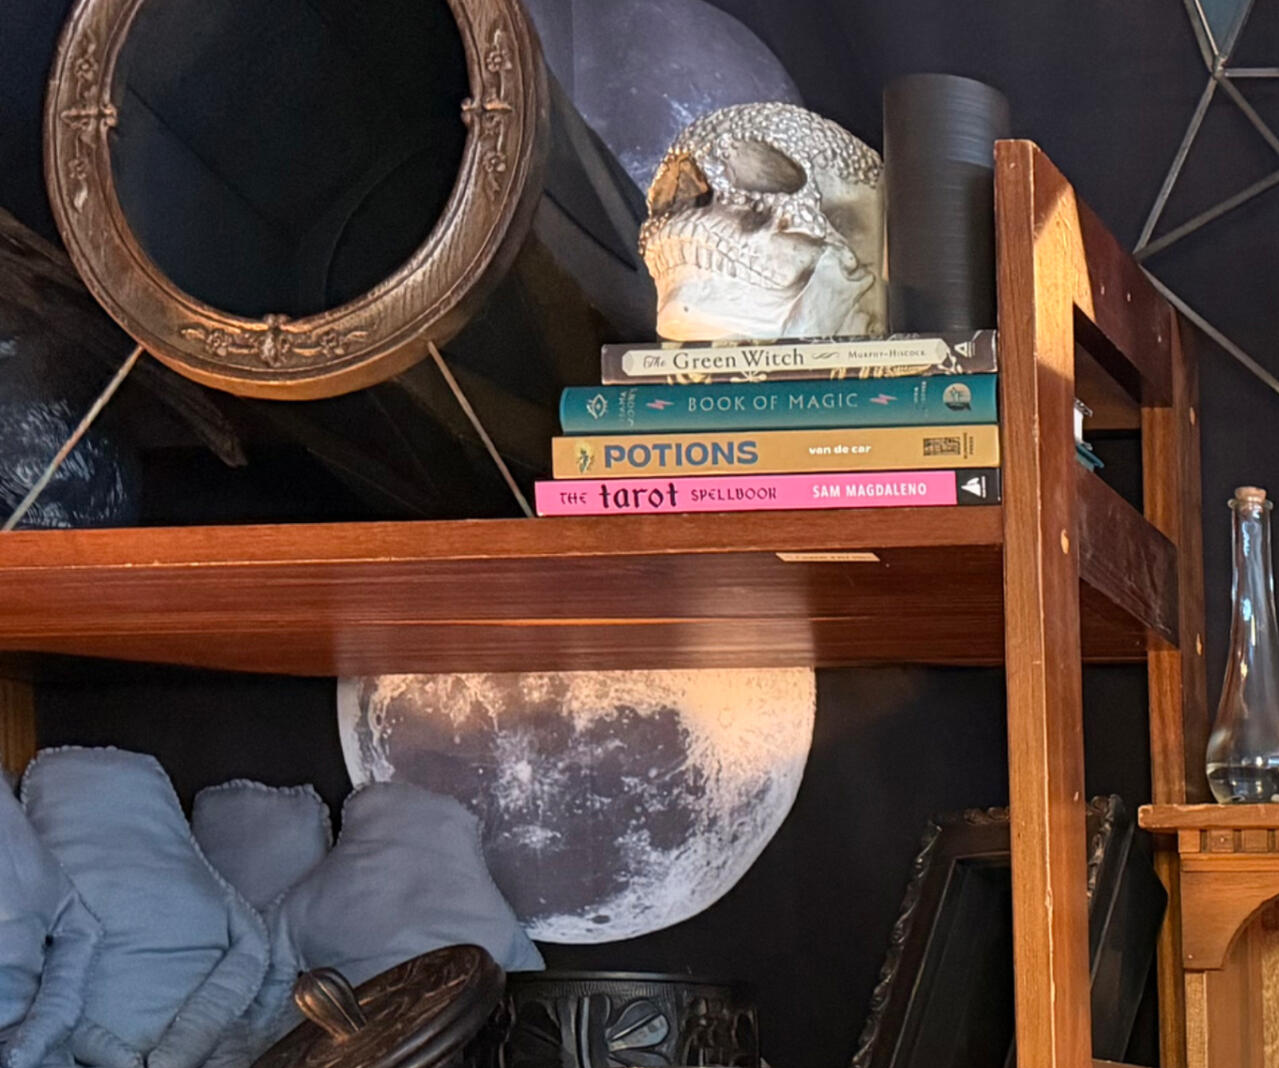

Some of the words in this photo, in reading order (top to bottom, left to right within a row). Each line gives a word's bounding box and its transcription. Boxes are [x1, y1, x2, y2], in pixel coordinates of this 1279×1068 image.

[643, 355, 666, 368] The
[673, 352, 736, 369] Green
[741, 349, 804, 367] Witch
[688, 396, 745, 412] BOOK
[753, 395, 778, 410] OF
[789, 393, 858, 410] MAGIC
[604, 441, 759, 468] POTIONS
[808, 446, 831, 455] van
[834, 444, 850, 454] de
[851, 445, 871, 453] car
[560, 492, 587, 505] THE
[599, 482, 678, 508] tarot
[691, 487, 777, 502] SPELLBOOK
[812, 485, 841, 498] SAM
[846, 483, 927, 497] MAGDALENO
